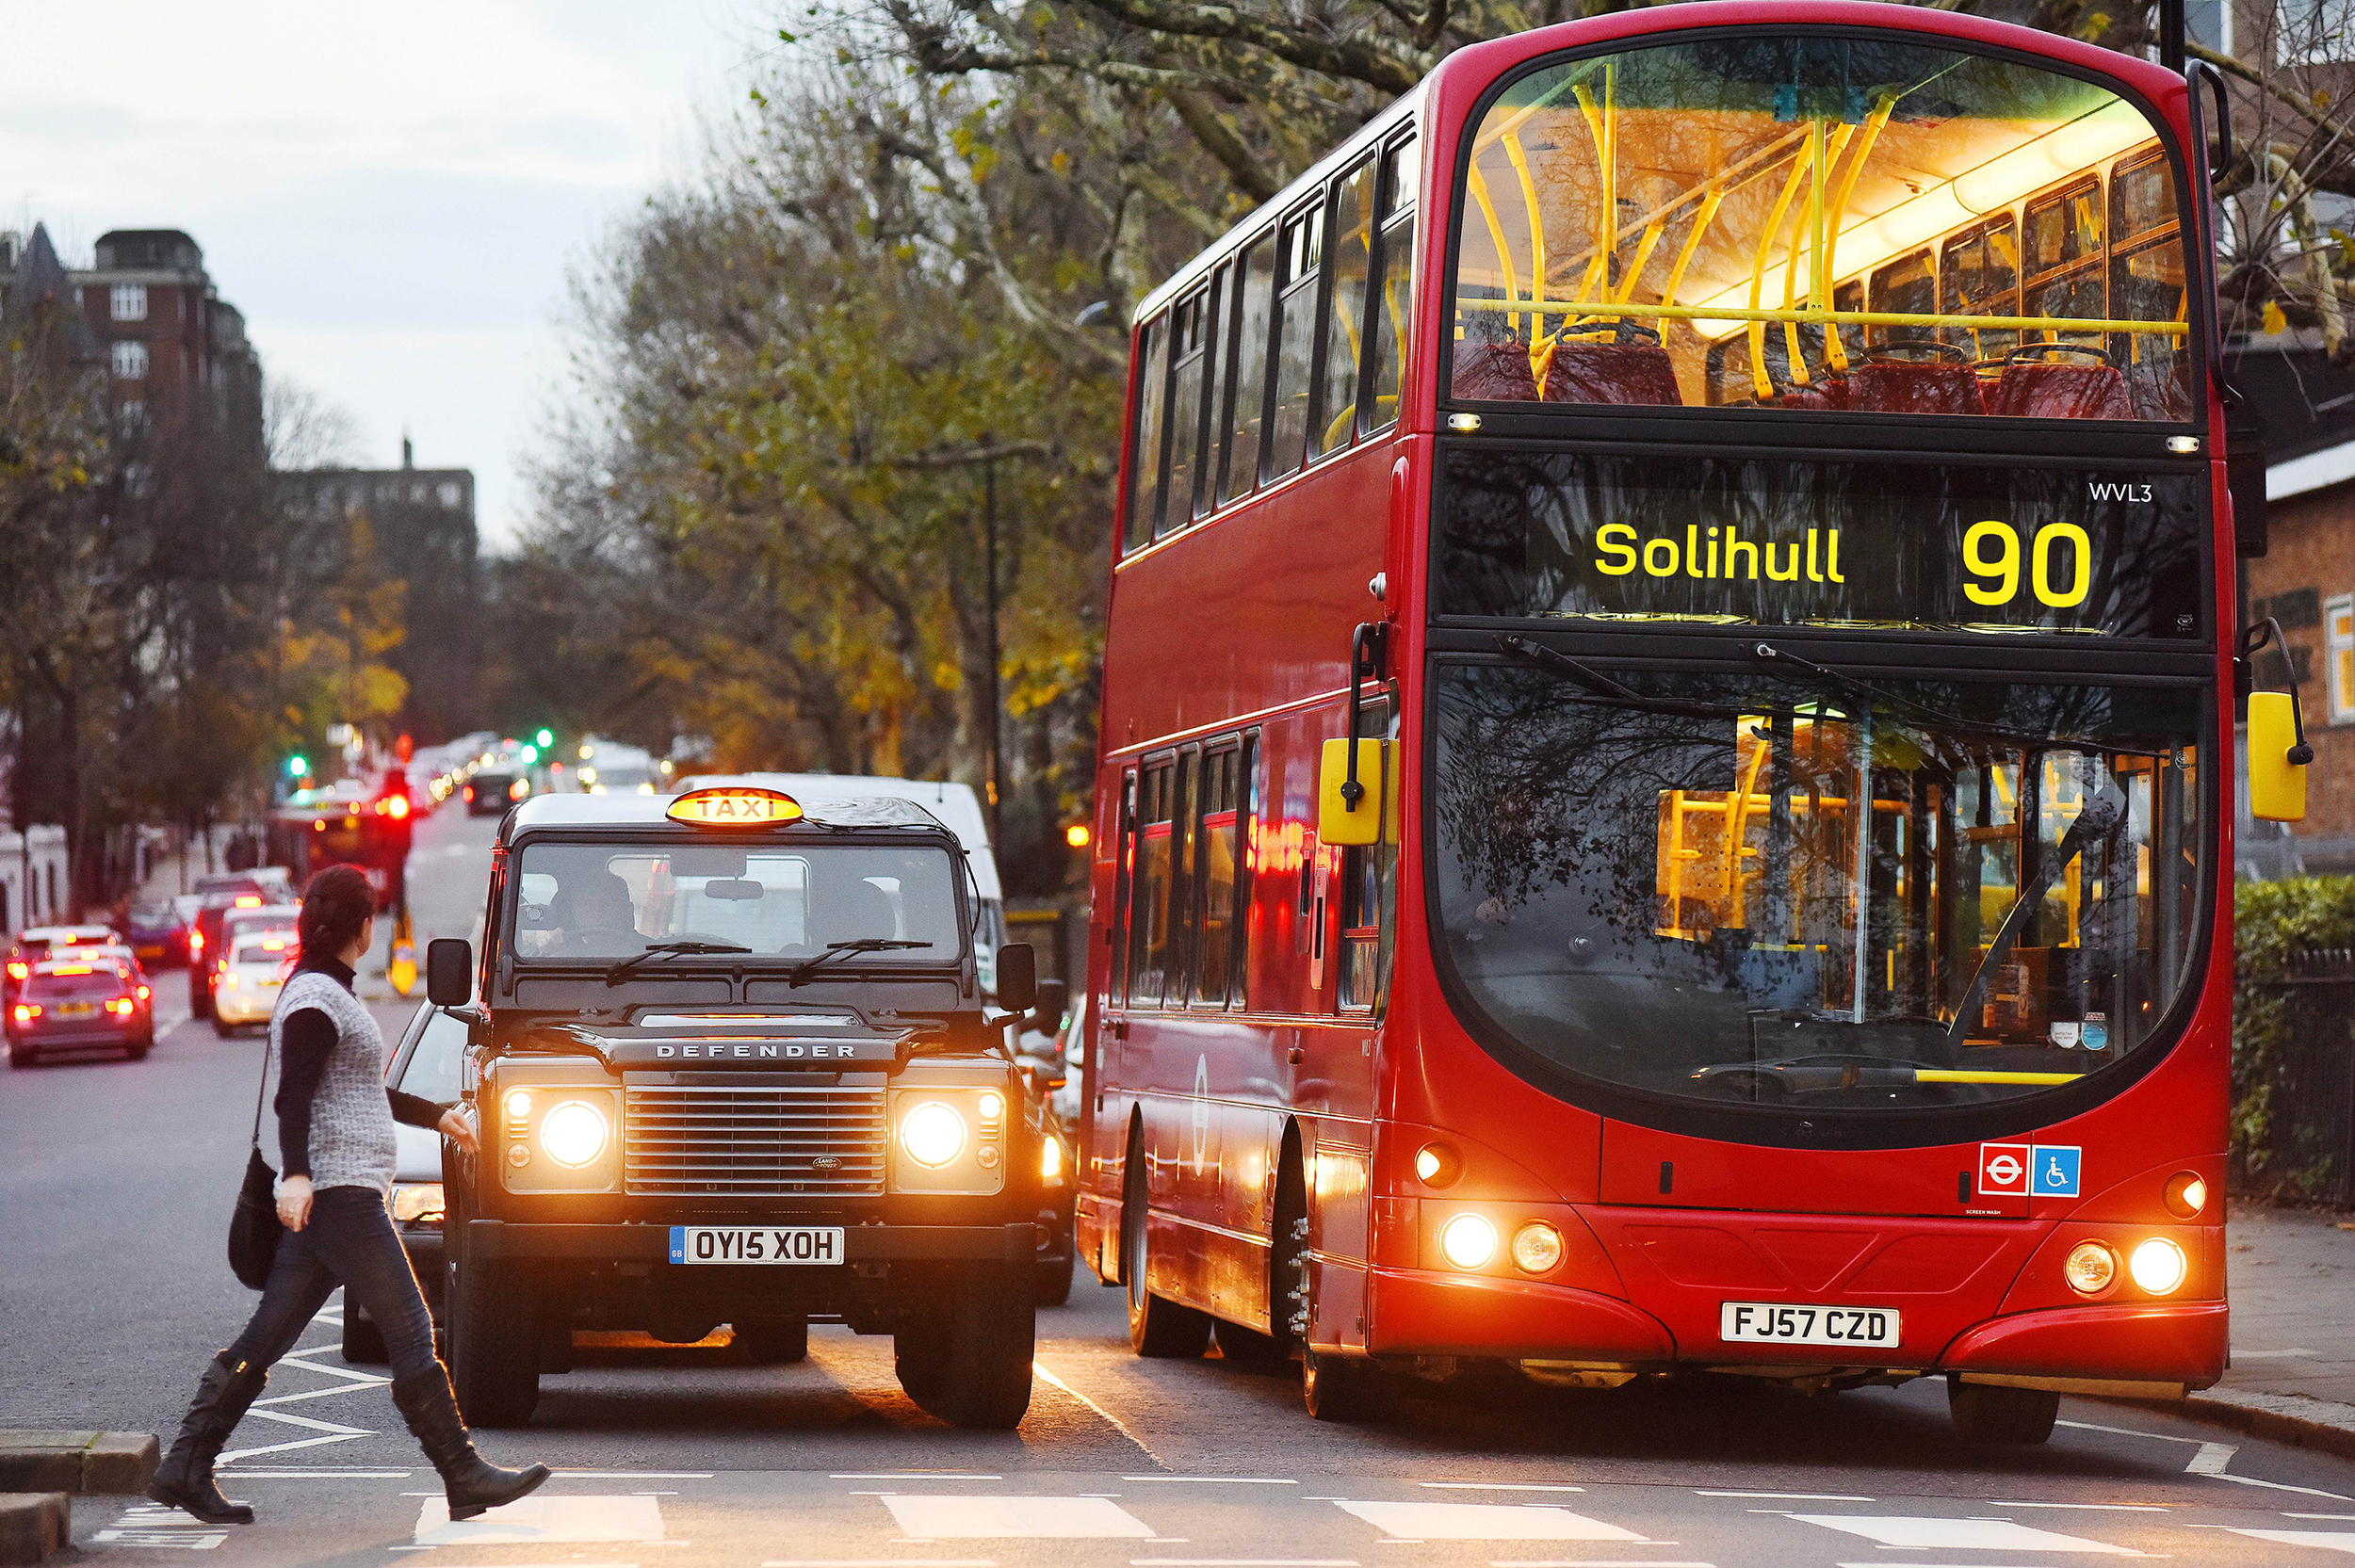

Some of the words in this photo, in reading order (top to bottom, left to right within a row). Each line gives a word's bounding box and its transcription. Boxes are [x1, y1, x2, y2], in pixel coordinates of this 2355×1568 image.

[2088, 482, 2152, 502] WVL3
[1595, 523, 1844, 583] Solihull
[1962, 520, 2090, 607] 90
[697, 800, 773, 816] TAXI
[656, 1045, 855, 1058] DEFENDER
[671, 1250, 683, 1258] GB
[696, 1232, 764, 1259] OY15
[773, 1232, 833, 1259] XOH
[1735, 1307, 1816, 1337] FJ57
[1827, 1311, 1886, 1341] CZD
